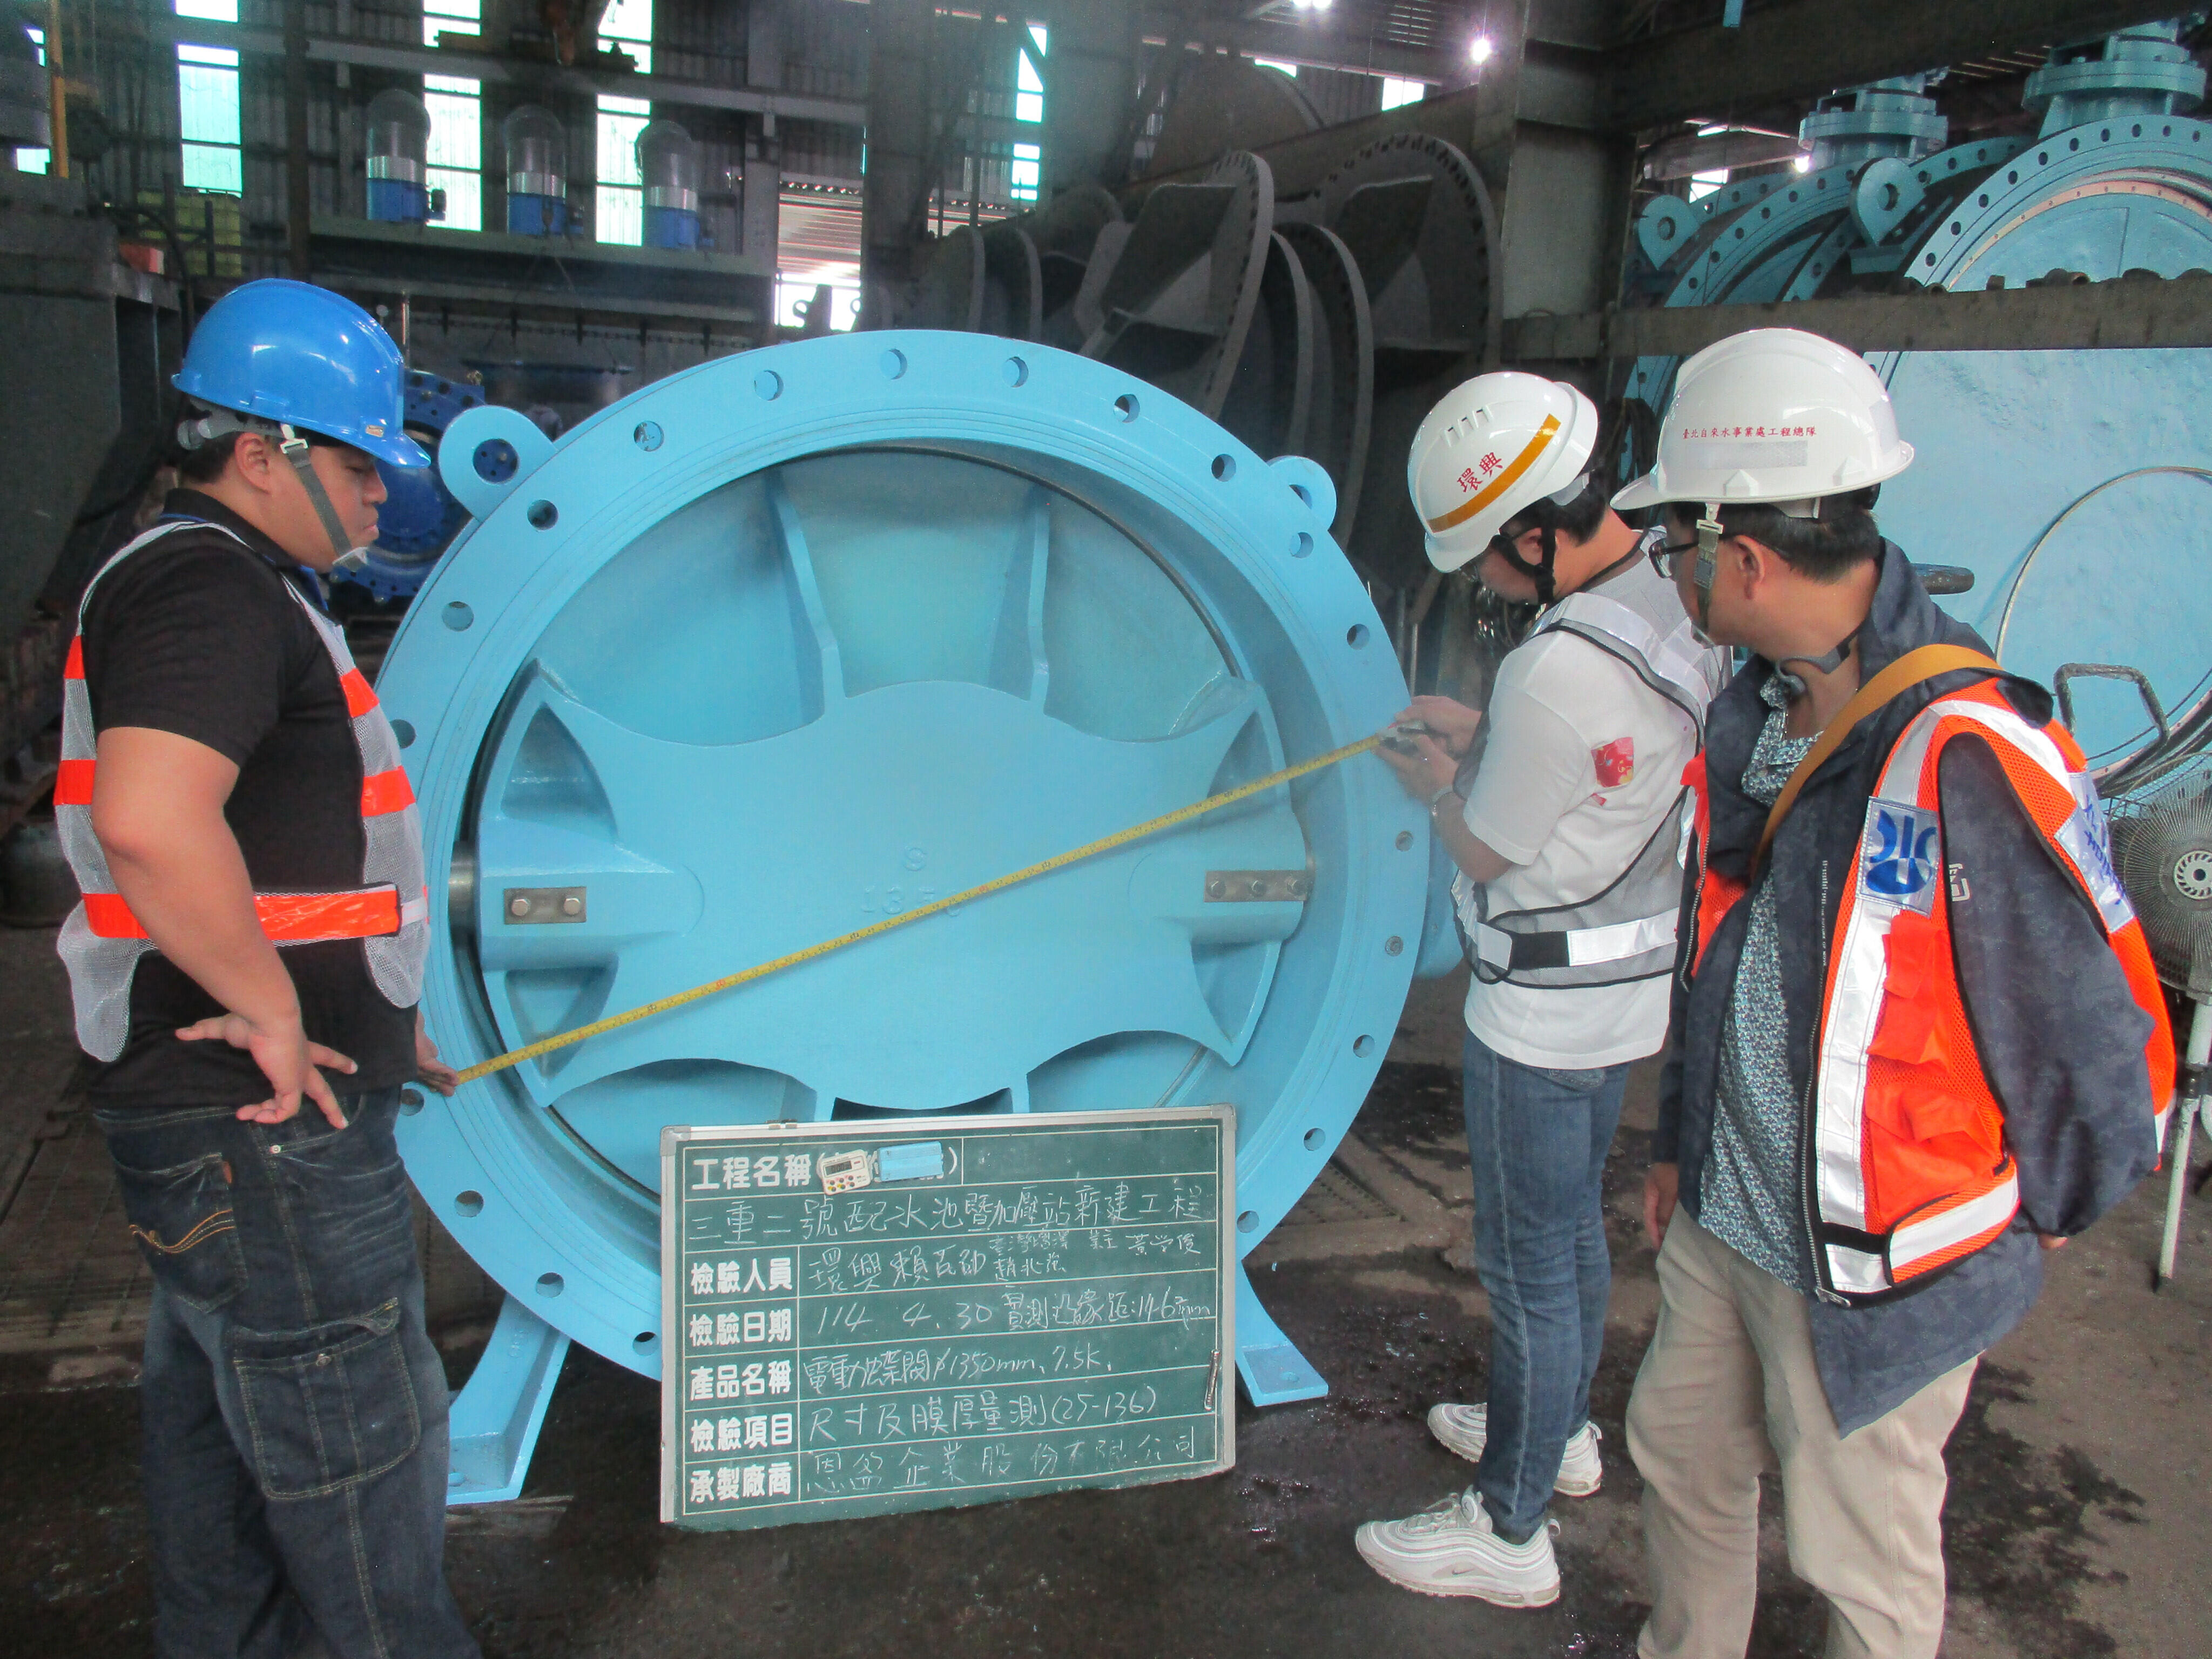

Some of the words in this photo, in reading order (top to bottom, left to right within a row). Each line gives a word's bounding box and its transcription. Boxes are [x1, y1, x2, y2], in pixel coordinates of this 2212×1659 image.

[1456, 451, 1503, 493] 環興
[691, 1257, 792, 1294] 檢驗人員
[690, 1309, 792, 1346] 檢驗日期
[690, 1360, 792, 1400] 產品名稱
[691, 1413, 792, 1453] 檢驗項目
[690, 1461, 792, 1503] 承製廠商
